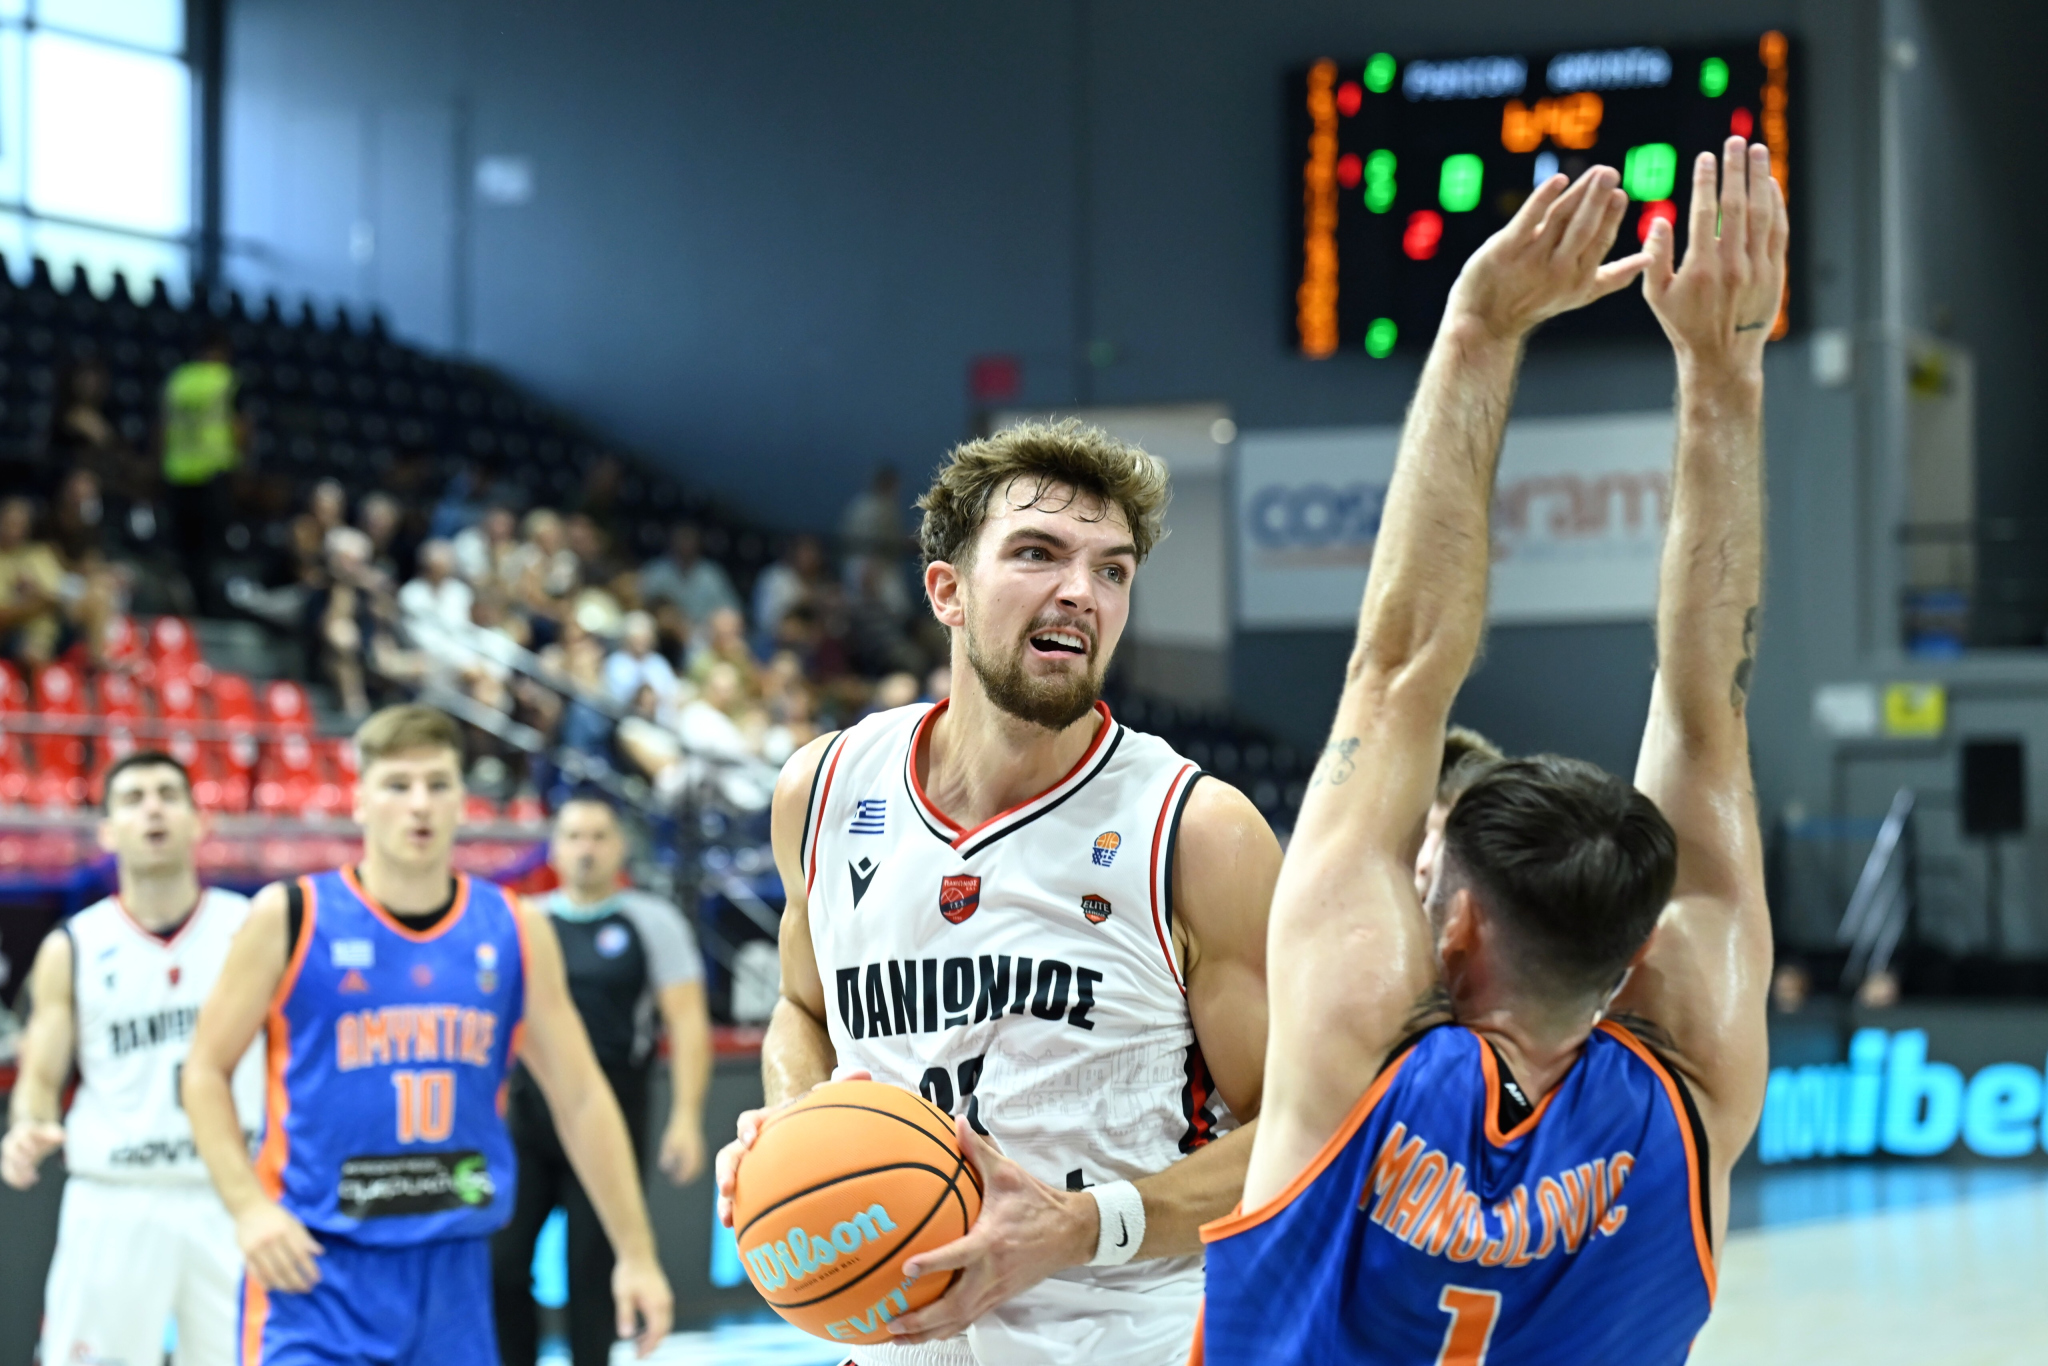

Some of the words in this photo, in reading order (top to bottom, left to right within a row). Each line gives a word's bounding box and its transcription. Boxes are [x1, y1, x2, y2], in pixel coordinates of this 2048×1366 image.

[1083, 900, 1110, 913] ELITE
[391, 1067, 457, 1145] 10
[1358, 1120, 1637, 1268] MANOJLOVIC
[745, 1203, 898, 1292] Wilson
[1435, 1284, 1502, 1366] 1
